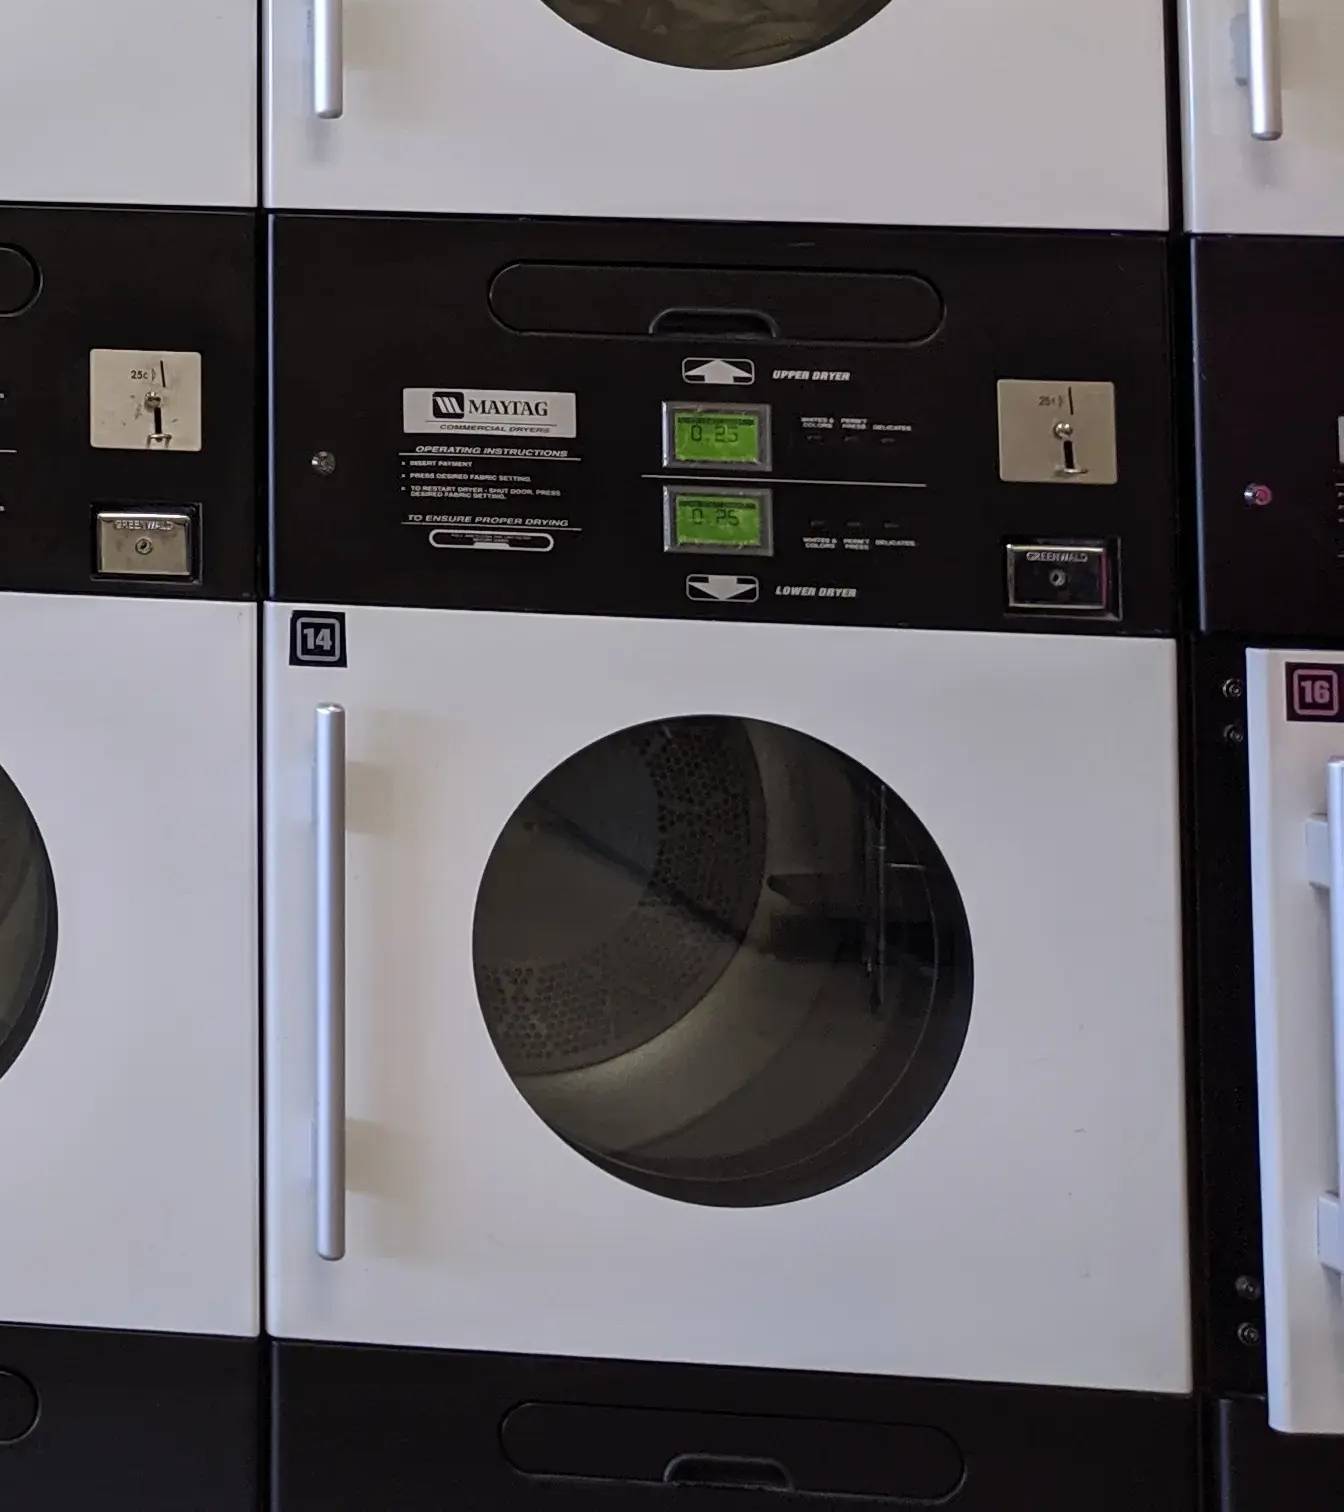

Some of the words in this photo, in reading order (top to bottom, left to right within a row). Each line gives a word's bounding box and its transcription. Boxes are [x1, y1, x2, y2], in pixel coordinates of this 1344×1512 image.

[772, 370, 809, 380] UPPER
[812, 371, 850, 381] DRYER
[468, 399, 548, 417] MAYTAG
[439, 424, 506, 432] COMMERCIAL
[508, 426, 550, 434] DRYERS
[415, 445, 481, 454] OPERATING
[483, 447, 568, 457] INSTRUCTIONS
[408, 514, 423, 522] TO
[426, 515, 472, 523] ENSURE
[474, 516, 522, 525] PROPER
[525, 518, 569, 527] DRYING
[775, 586, 816, 596] LOWER
[818, 587, 857, 598] DRYER
[303, 628, 332, 650] 14
[1300, 680, 1330, 703] 16
